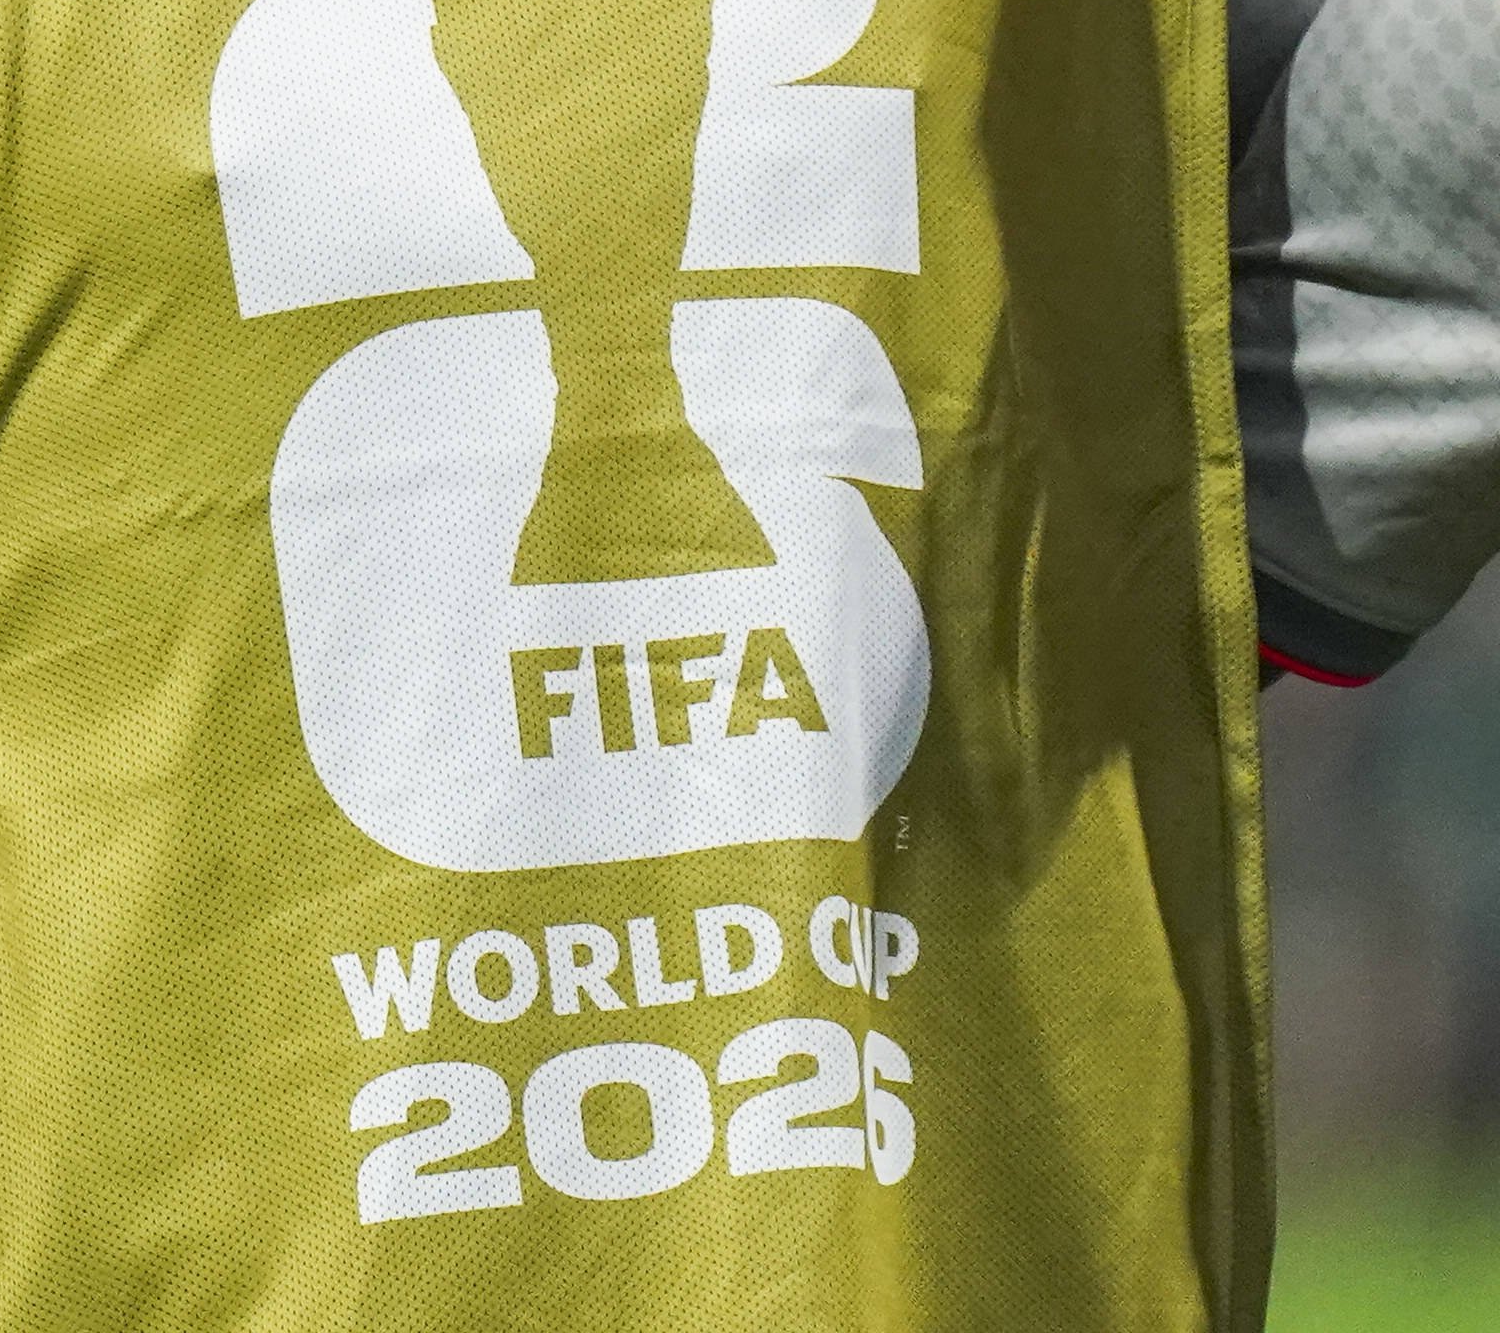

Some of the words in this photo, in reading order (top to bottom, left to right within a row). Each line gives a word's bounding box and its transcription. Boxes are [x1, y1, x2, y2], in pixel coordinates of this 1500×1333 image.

[509, 628, 829, 760] FIFA
[331, 904, 784, 1040] WORLD
[809, 895, 920, 1001] CUP
[349, 1017, 916, 1225] 2026
